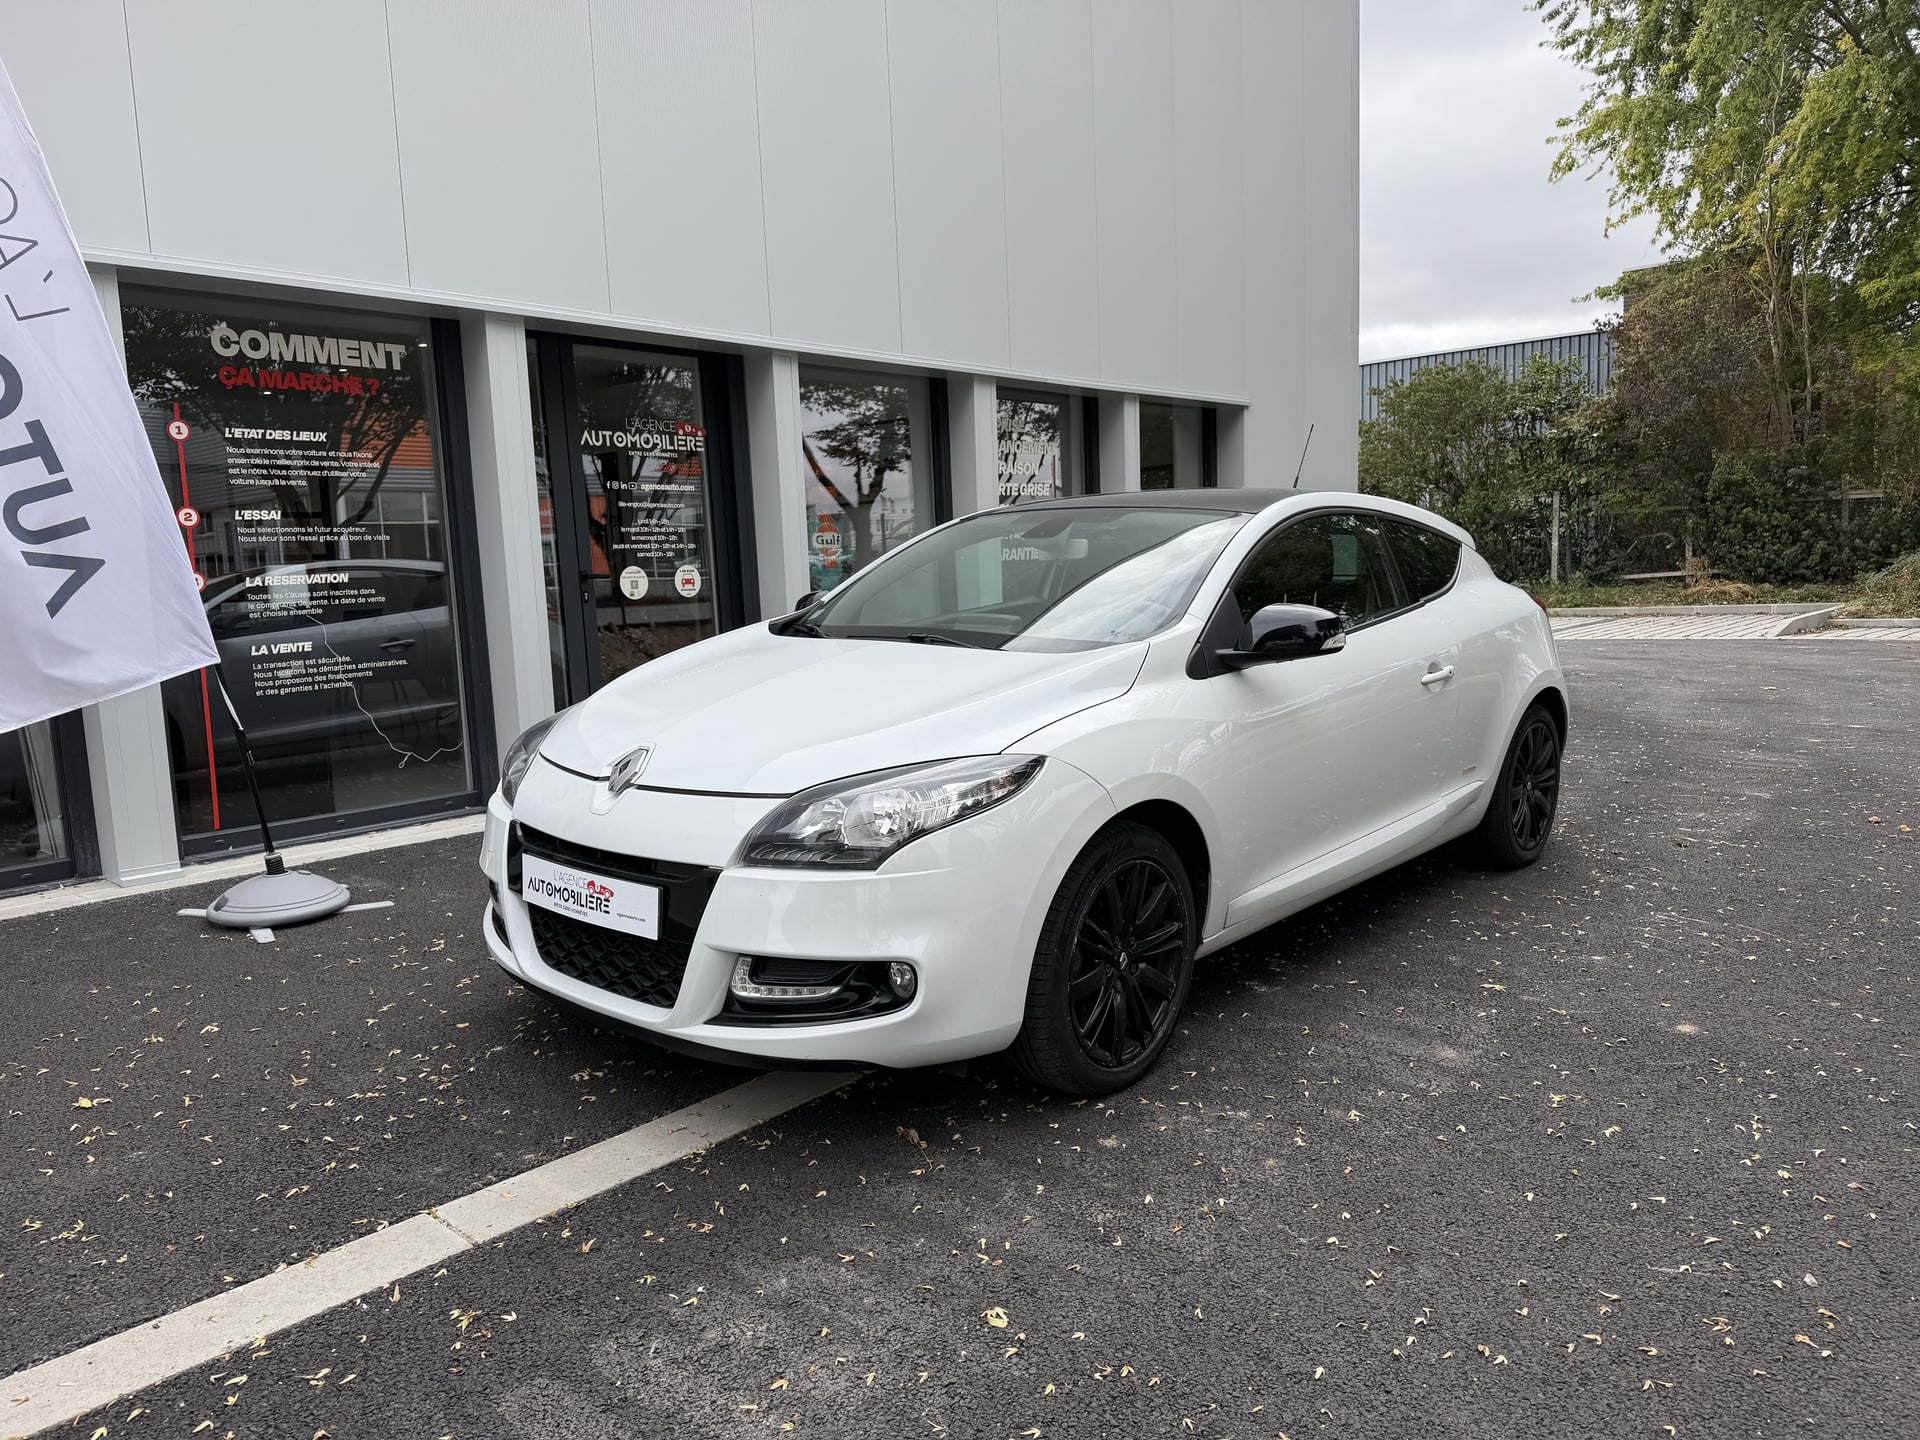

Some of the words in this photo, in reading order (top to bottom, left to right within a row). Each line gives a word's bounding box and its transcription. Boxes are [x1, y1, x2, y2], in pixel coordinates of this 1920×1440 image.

[210, 327, 406, 371] COMMENT
[218, 366, 256, 390] ÇA
[258, 369, 364, 395] MARCHE
[366, 378, 380, 396] ?
[175, 426, 183, 435] 1
[625, 417, 677, 433] L'AGENCE
[225, 428, 264, 440] L'ETAT
[266, 430, 291, 441] DES
[292, 431, 328, 442] LIEUX
[226, 446, 245, 454] Nous
[246, 448, 284, 456] examinons
[285, 448, 302, 456] votre
[303, 449, 327, 457] voiture
[353, 451, 373, 459] fixons
[227, 457, 262, 465] ensemble
[310, 459, 319, 467] de
[340, 460, 358, 468] Votre
[240, 467, 247, 475] le
[269, 468, 287, 476] Vous
[287, 469, 321, 477] continuez
[349, 470, 366, 478] votre
[229, 478, 255, 486] voiture
[280, 478, 286, 486] la
[641, 483, 695, 491] agenceauto.com
[1020, 483, 1050, 497] GRISE
[184, 512, 193, 521] 2
[235, 510, 281, 520] L'ESSAI
[314, 525, 331, 533] futur
[238, 535, 257, 543] Nous
[319, 534, 338, 543] grâce
[815, 534, 841, 546] Gulf
[1001, 547, 1040, 561] RANTIE
[245, 577, 263, 588] LA
[265, 573, 349, 587] RESERVATION
[247, 593, 271, 601] Toutes
[273, 592, 283, 600] les
[329, 588, 358, 596] inscrites
[248, 602, 255, 610] le
[340, 596, 356, 604] date
[367, 595, 386, 603] vente
[249, 611, 261, 619] est
[262, 610, 288, 618] choisie
[289, 608, 323, 617] ensemble
[251, 645, 269, 656] LA
[270, 641, 312, 654] VENTE
[253, 671, 273, 679] Nous
[307, 667, 317, 675] les
[318, 663, 357, 674] démarches
[357, 658, 408, 670] administratives.
[263, 660, 304, 670] transaction
[305, 658, 317, 666] est
[254, 680, 274, 688] Nous
[275, 677, 313, 687] proposons
[314, 675, 326, 683] des
[327, 670, 373, 681] financements
[255, 689, 264, 697] et
[265, 688, 278, 696] des
[280, 685, 313, 696] garanties
[553, 869, 588, 890] L'AGENCE
